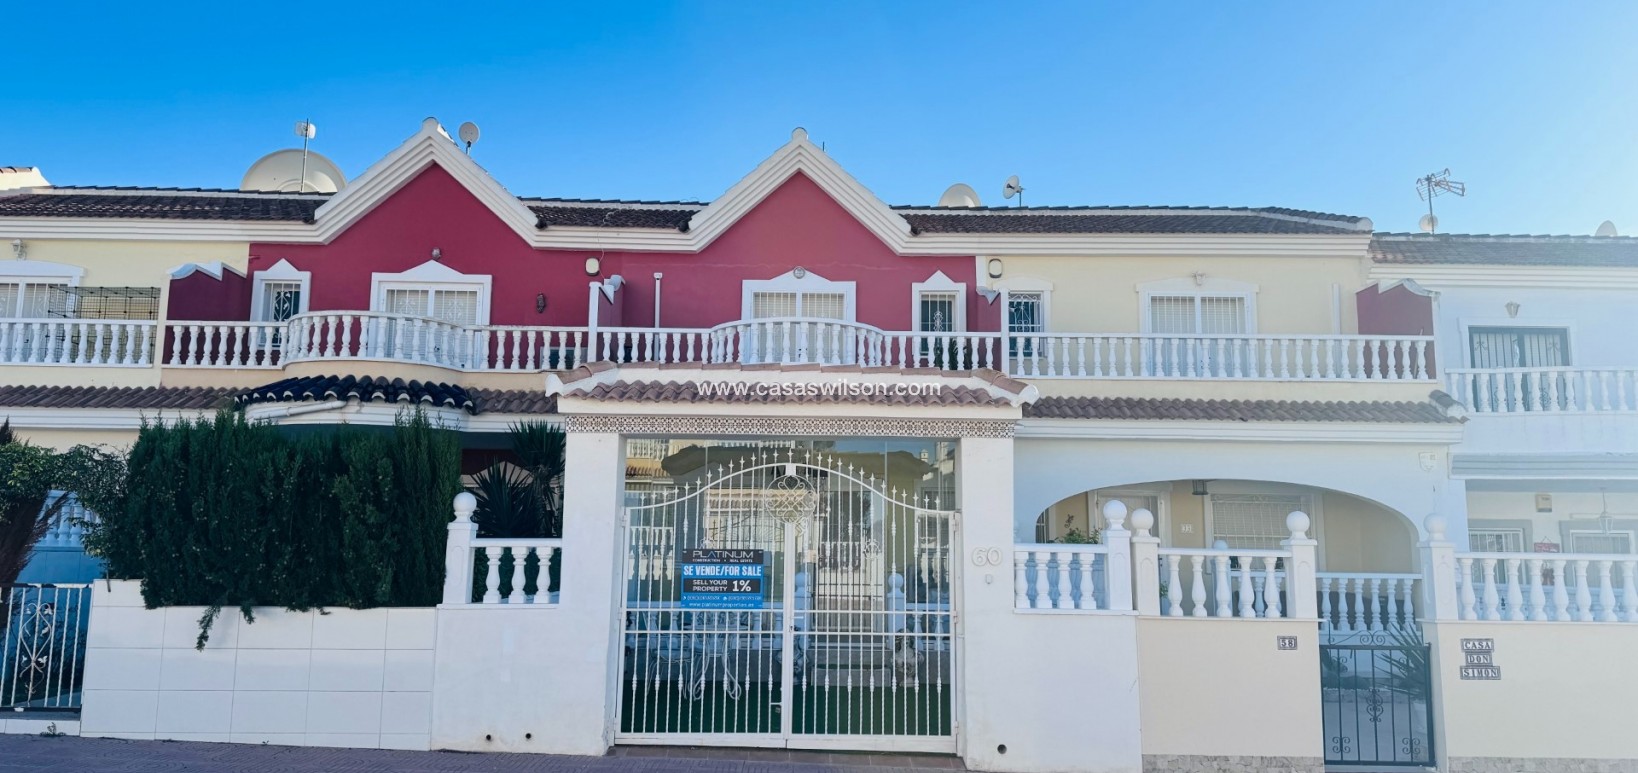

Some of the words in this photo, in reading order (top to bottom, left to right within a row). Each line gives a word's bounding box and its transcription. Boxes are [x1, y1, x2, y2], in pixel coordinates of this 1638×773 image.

[692, 550, 754, 559] PLATINUM
[971, 547, 1003, 567] 60
[683, 565, 694, 576] SE
[695, 565, 740, 576] VENDE/FOR
[741, 565, 762, 576] SALE
[732, 580, 752, 592] 1%
[1281, 639, 1294, 648] 58
[1464, 641, 1491, 649] CASA
[1469, 655, 1489, 663] DON
[1463, 669, 1498, 677] SIMON
